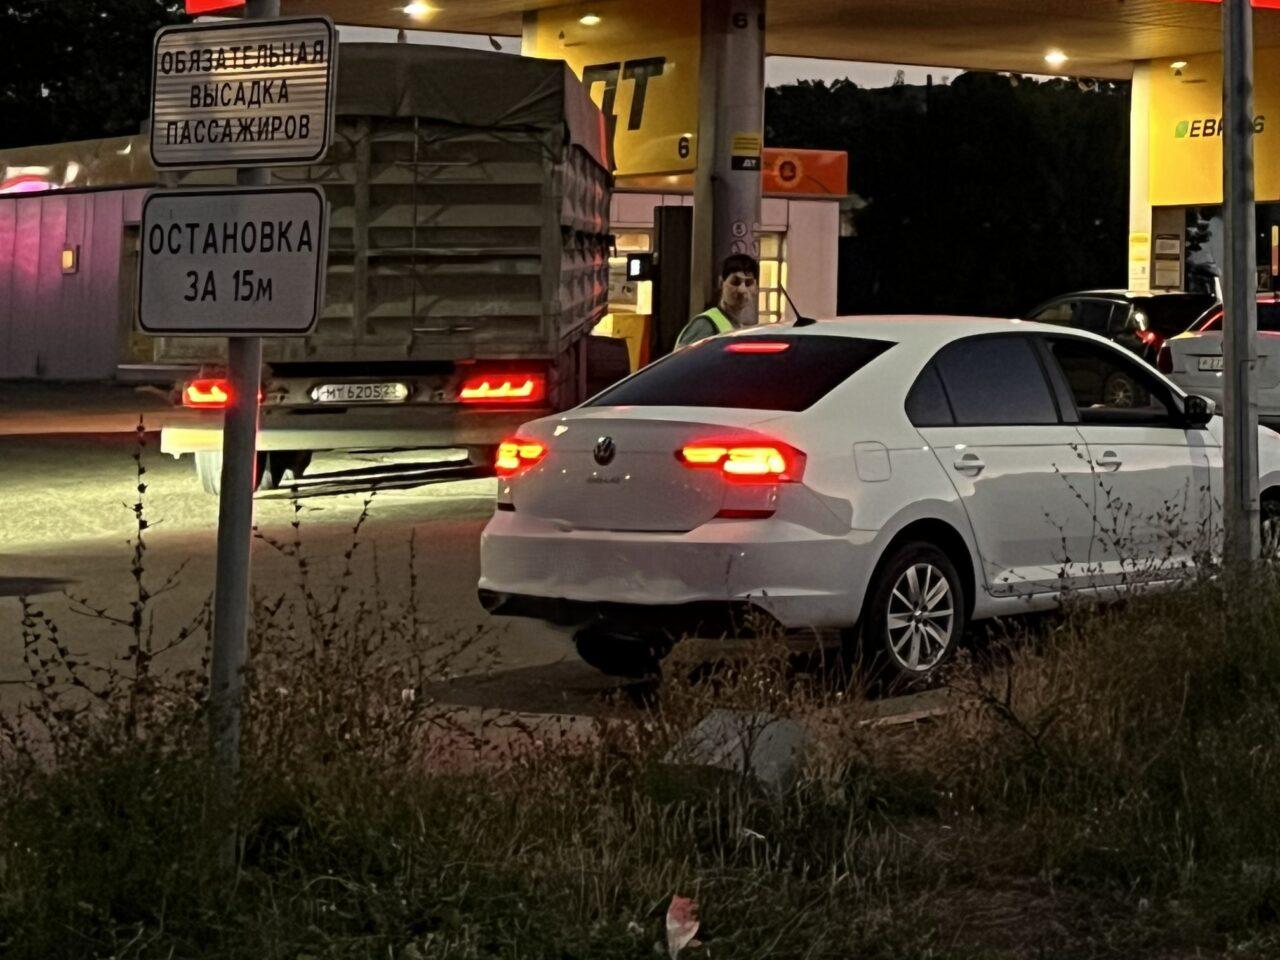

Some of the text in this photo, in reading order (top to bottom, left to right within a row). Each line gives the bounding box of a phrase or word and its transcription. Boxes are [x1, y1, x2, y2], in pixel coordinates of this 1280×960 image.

[732, 12, 748, 29] 6
[160, 40, 325, 74] ОБЯЗАТЕЛЬНАЯ
[190, 79, 290, 109] ВЫСАДКА
[166, 114, 311, 146] ПАССАЖИРОВ
[678, 136, 690, 159] 6
[149, 219, 313, 255] ОСТАНОВКА
[183, 270, 218, 302] ЗА
